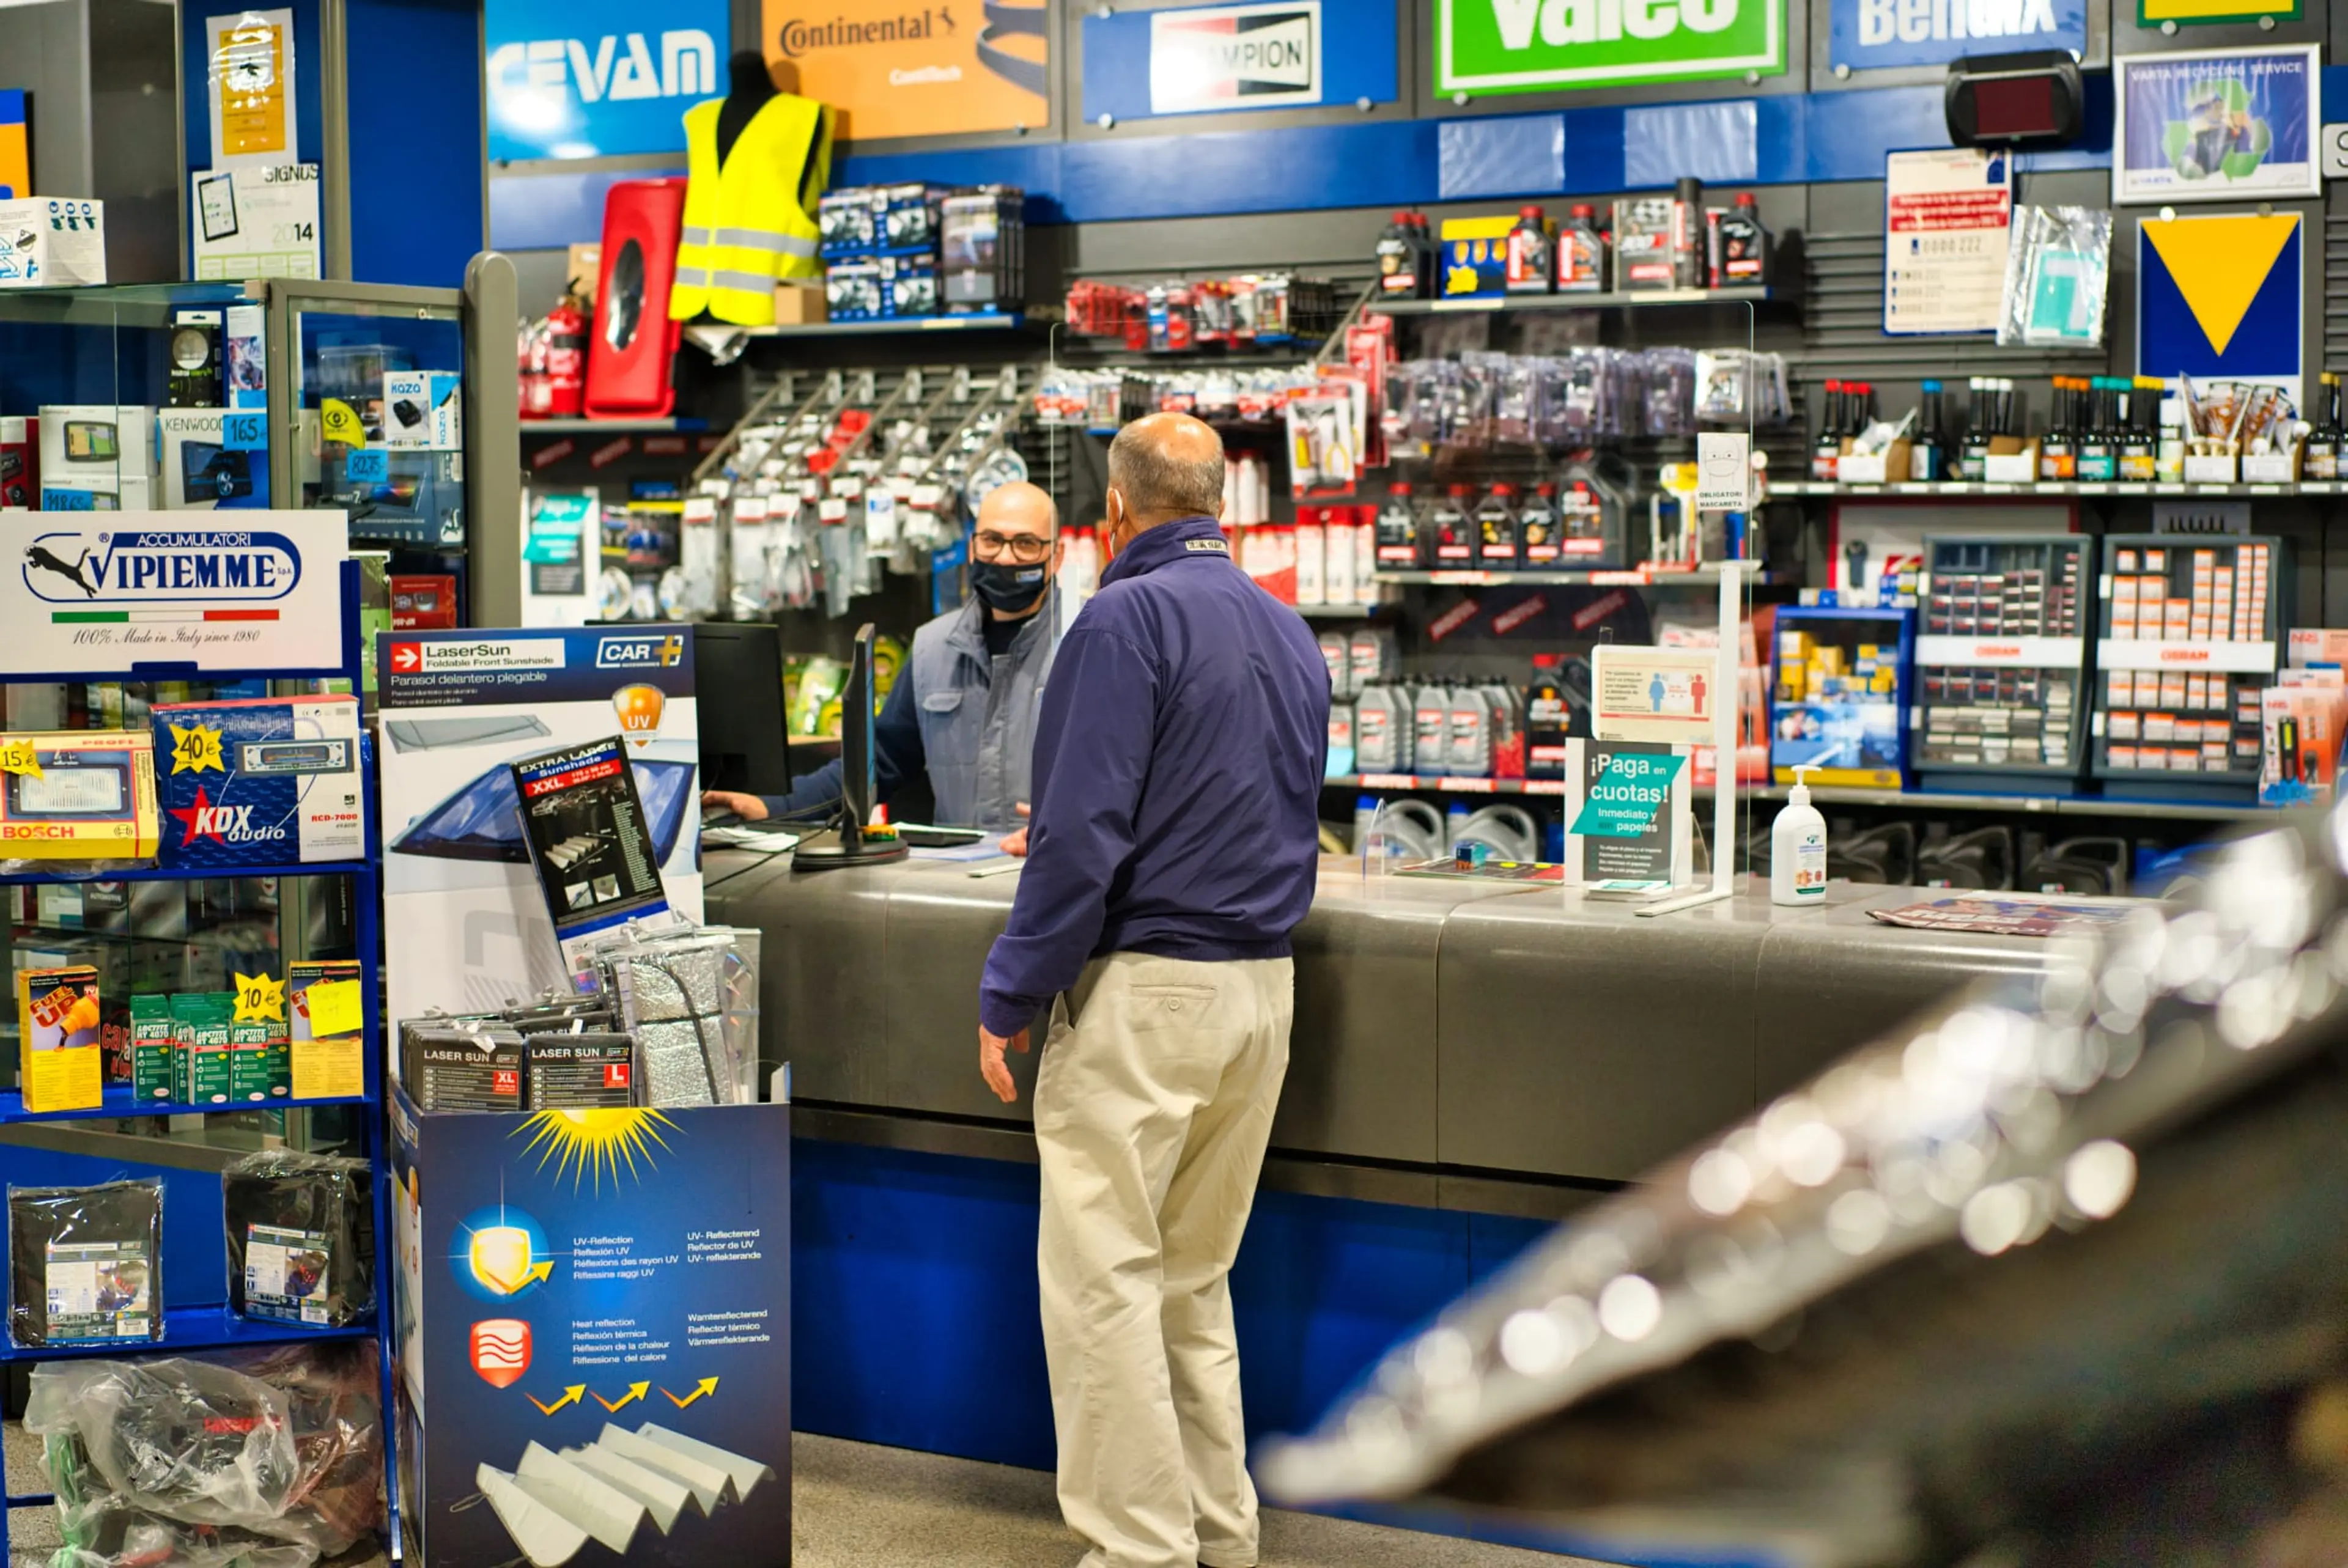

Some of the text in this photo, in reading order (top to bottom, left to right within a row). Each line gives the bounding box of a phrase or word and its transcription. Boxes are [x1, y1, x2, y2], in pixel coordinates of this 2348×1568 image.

[780, 9, 932, 58] Continental
[488, 29, 717, 103] CEVAM
[2250, 62, 2303, 76] SERVICE
[231, 418, 258, 442] 165
[137, 533, 251, 547] ACCUMULATORI
[88, 553, 277, 589] VIPIEMME
[73, 628, 260, 649] 100% Made in Italy since 1980
[426, 644, 511, 658] LaserSun
[605, 644, 651, 661] CAR
[426, 656, 555, 668] Foldable Front Sunshade
[391, 671, 548, 686] Parasol delantero plegable
[627, 715, 651, 729] UV
[180, 734, 204, 760] 40
[2, 751, 22, 767] 15
[520, 756, 566, 774] EXTRA
[1590, 753, 1666, 779] ¡Paga en
[539, 756, 602, 778] Sunshade
[532, 777, 564, 795] XXL
[1590, 784, 1669, 803] cuotas!
[194, 804, 254, 834] KDX
[1598, 807, 1657, 823] Inmediato y
[2, 826, 75, 839] BOSCH
[1616, 822, 1658, 833] papeles
[29, 985, 73, 1014] FUEL
[244, 987, 262, 1009] 10
[35, 994, 78, 1028] UP
[424, 1049, 490, 1062] LASER SUN
[531, 1047, 600, 1059] LASER SUN
[498, 1072, 515, 1083] XL
[611, 1064, 624, 1081] L
[573, 1236, 634, 1246] UV-Reflection
[728, 1241, 739, 1250] de
[740, 1240, 755, 1248] UV
[616, 1246, 630, 1255] UV
[621, 1257, 638, 1266] des
[665, 1255, 679, 1264] UV
[641, 1268, 655, 1277] UV
[572, 1319, 635, 1328] Heat reflection
[615, 1342, 626, 1351] de
[640, 1352, 667, 1362] calore
